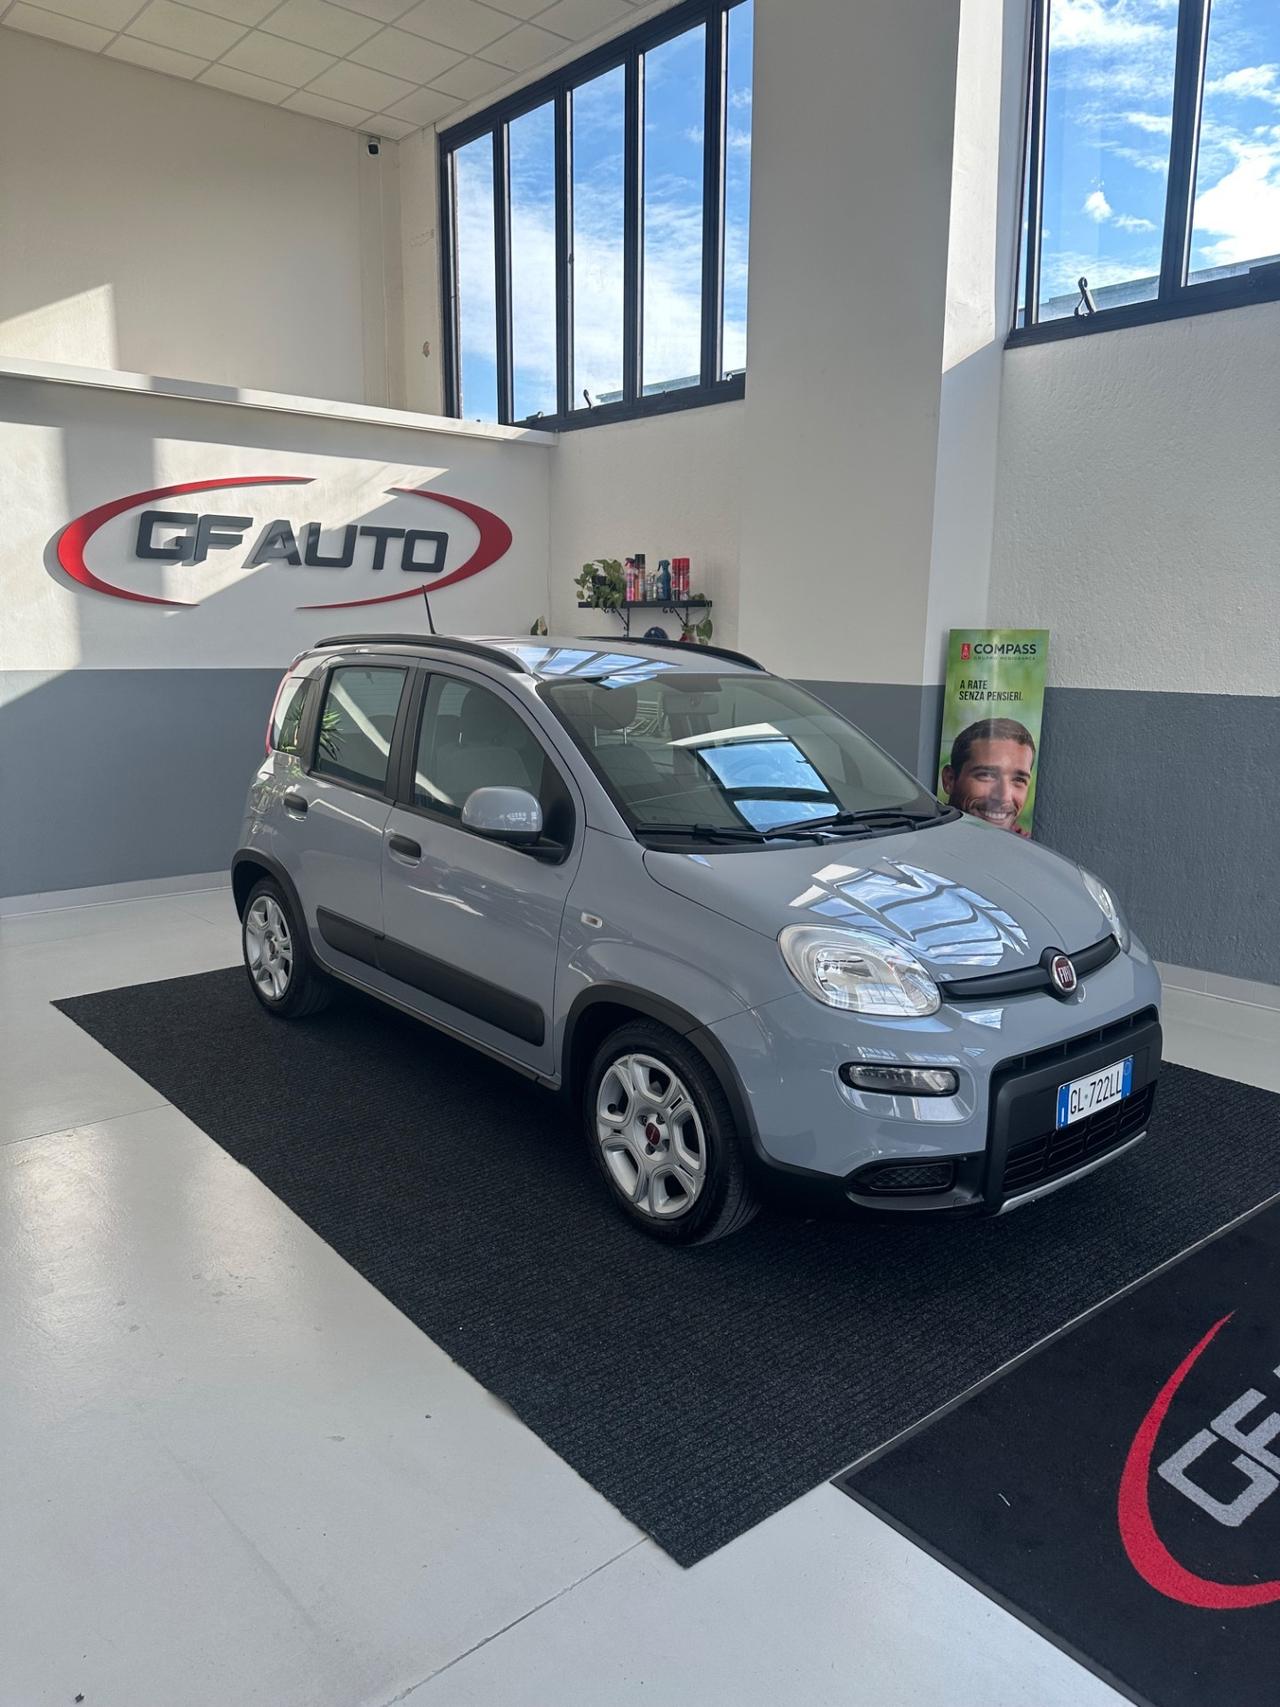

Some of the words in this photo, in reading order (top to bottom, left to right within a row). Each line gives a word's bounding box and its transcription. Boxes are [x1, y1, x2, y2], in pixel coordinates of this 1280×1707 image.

[136, 510, 254, 565] GF
[243, 519, 448, 573] AUTO
[974, 643, 1037, 655] COMPASS
[960, 680, 965, 690] A
[967, 680, 988, 690] RATE
[959, 690, 985, 701] SENZA
[987, 691, 1024, 701] PENSIERI.
